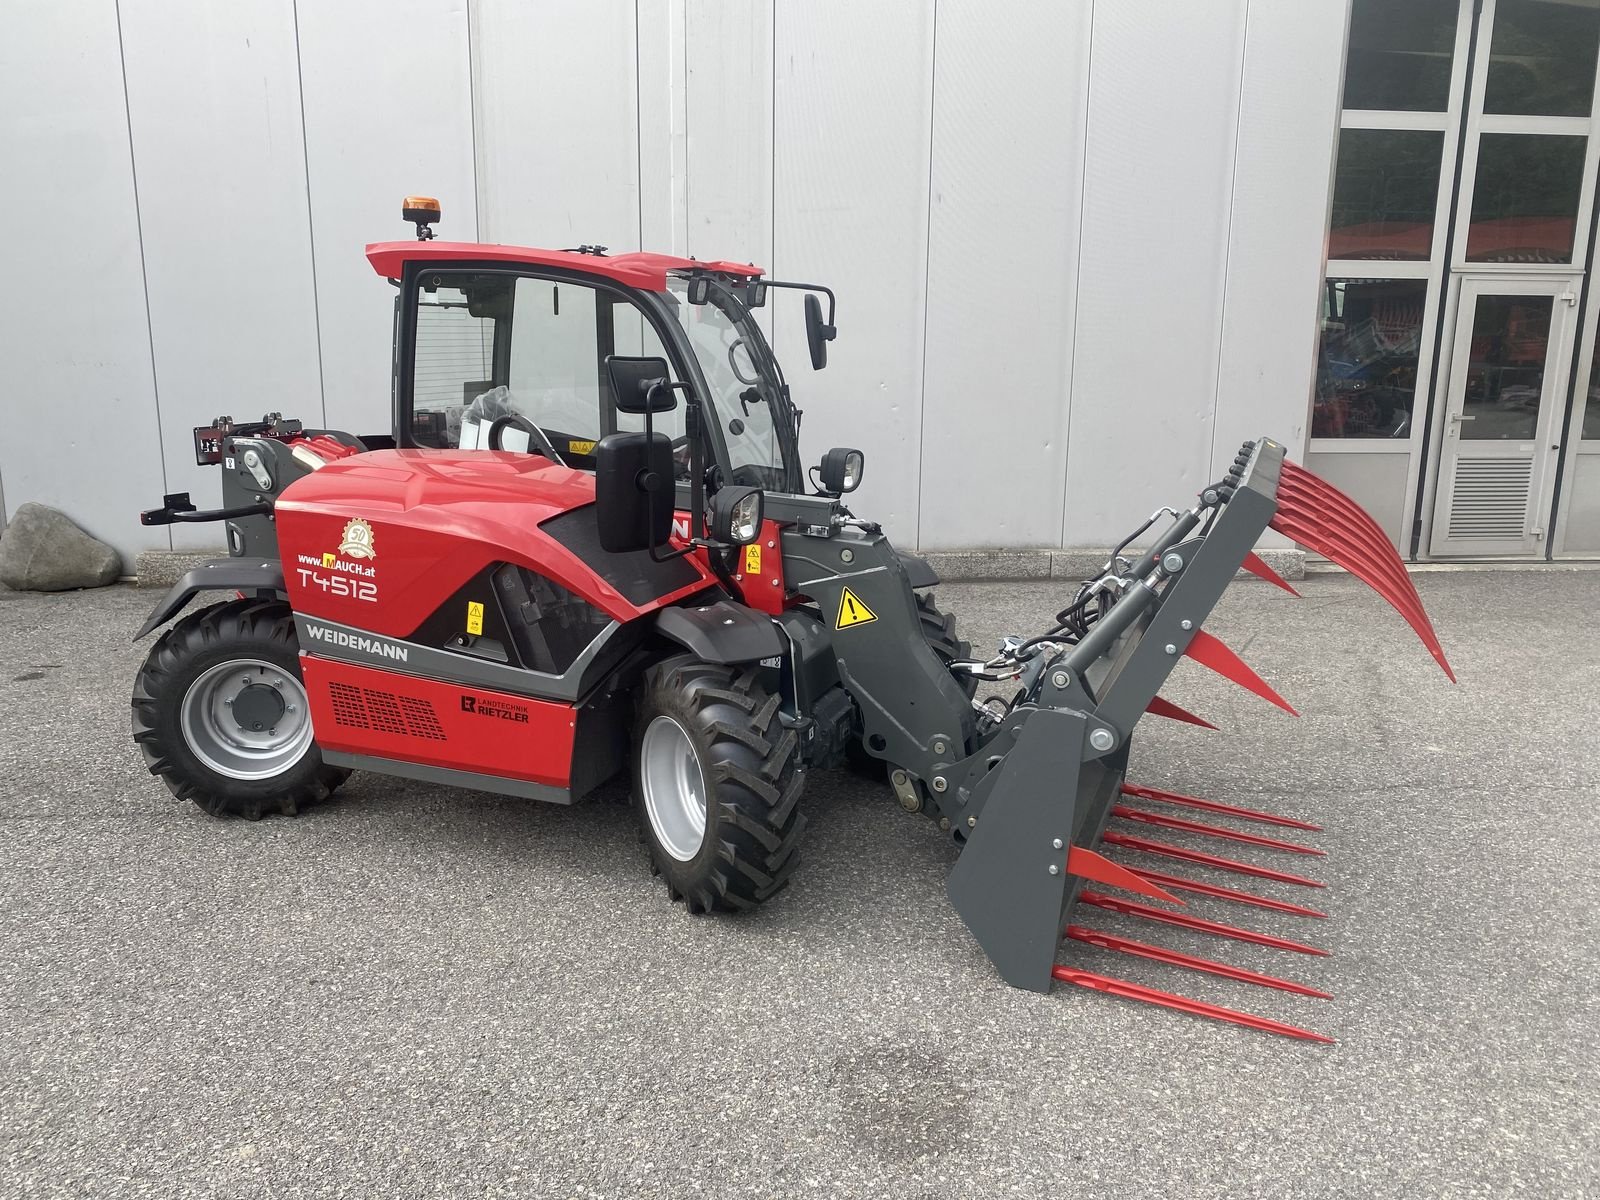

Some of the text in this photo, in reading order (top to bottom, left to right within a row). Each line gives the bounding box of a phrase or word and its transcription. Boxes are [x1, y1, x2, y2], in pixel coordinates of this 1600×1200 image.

[297, 554, 377, 577] www.MAUCH.at
[297, 569, 378, 602] T4512
[307, 625, 407, 662] WEIDEMANN
[478, 699, 528, 713] LANDTECHNIK
[478, 705, 529, 723] RIETZLER
